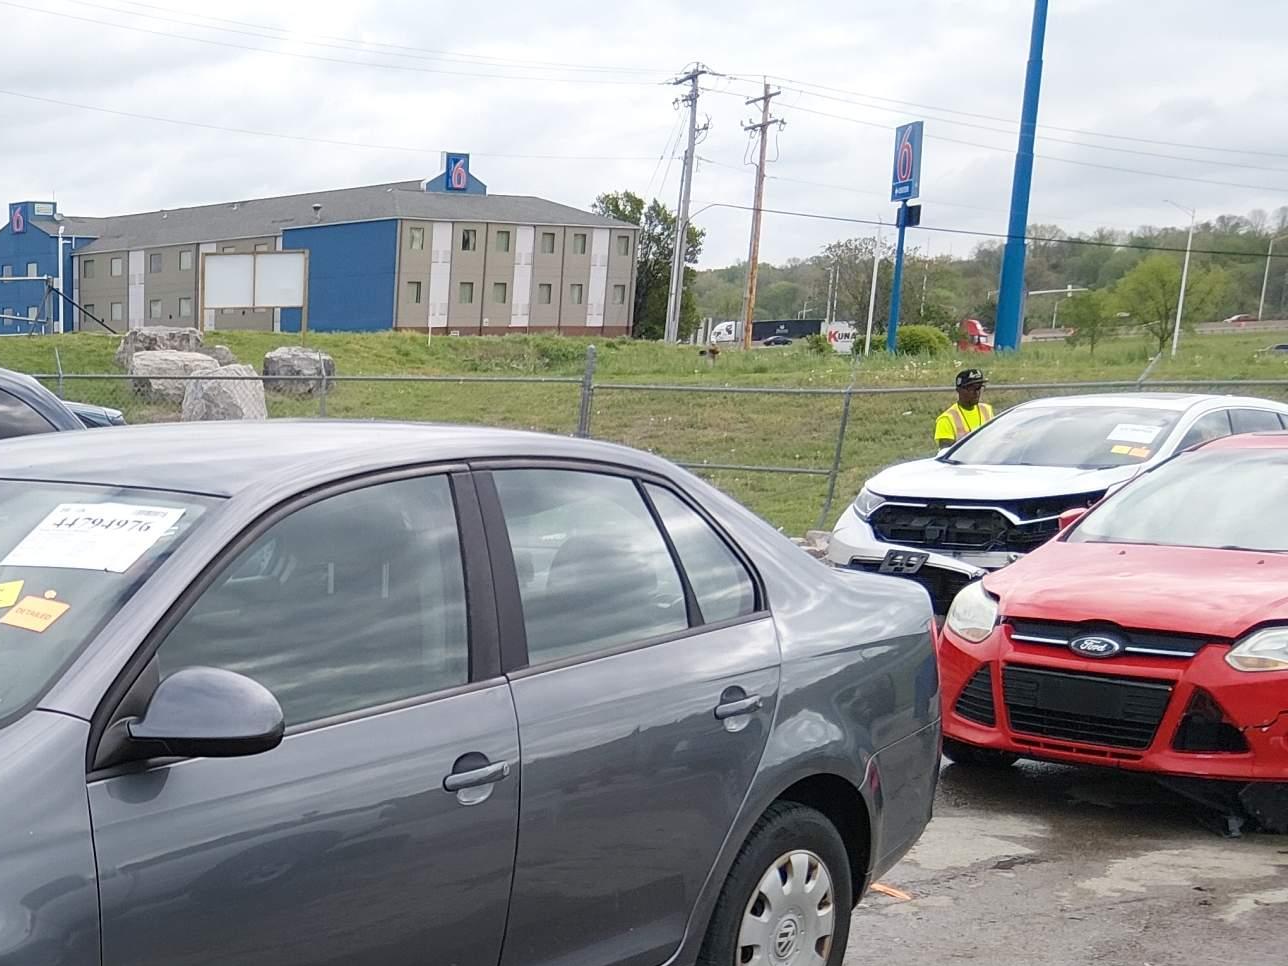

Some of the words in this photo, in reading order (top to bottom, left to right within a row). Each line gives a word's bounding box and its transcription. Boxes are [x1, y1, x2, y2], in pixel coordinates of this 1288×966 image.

[896, 125, 913, 183] 6
[452, 159, 467, 189] 6
[12, 206, 24, 233] 6
[52, 516, 153, 532] 44794976
